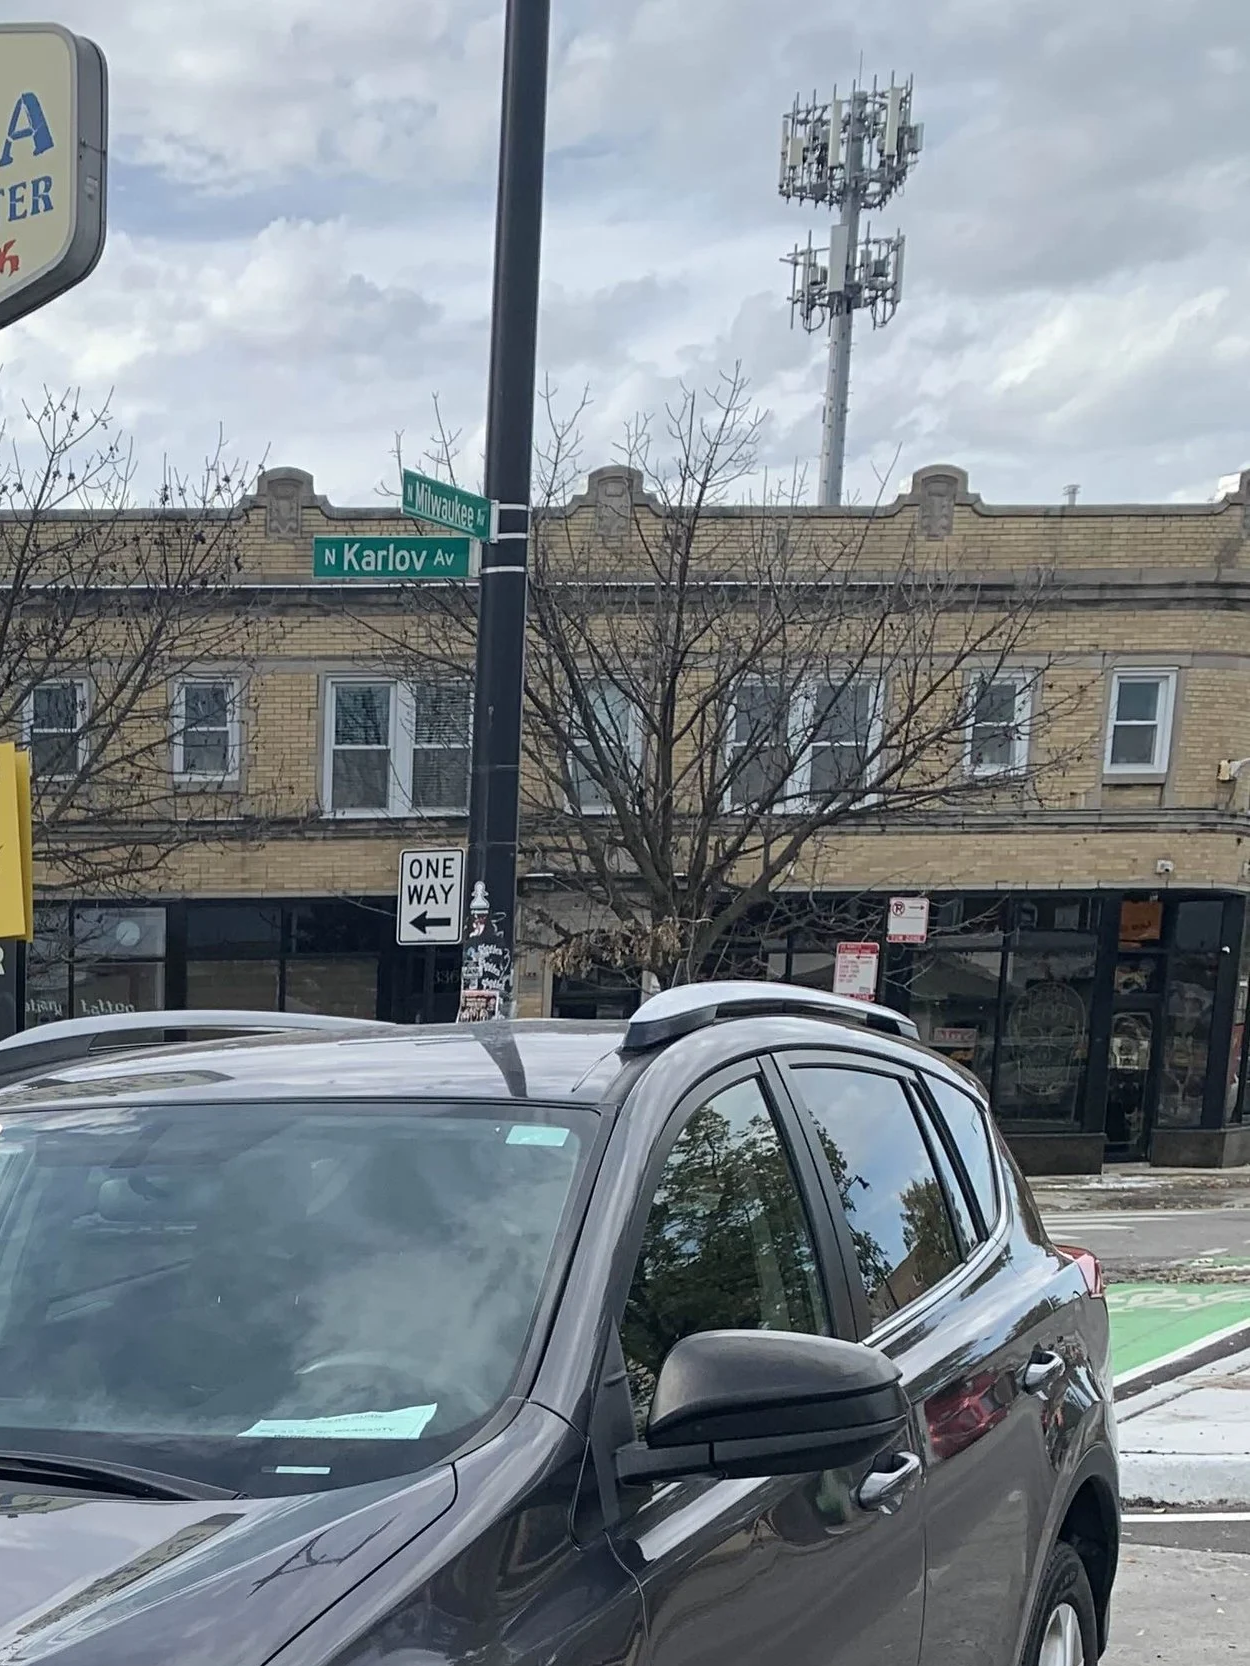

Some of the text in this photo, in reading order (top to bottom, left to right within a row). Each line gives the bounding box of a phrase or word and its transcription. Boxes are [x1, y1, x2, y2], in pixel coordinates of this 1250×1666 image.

[407, 481, 485, 528] N Milwaukee Av
[325, 543, 454, 571] N Karlov Av
[409, 858, 455, 879] ONE
[407, 884, 455, 906] WAY
